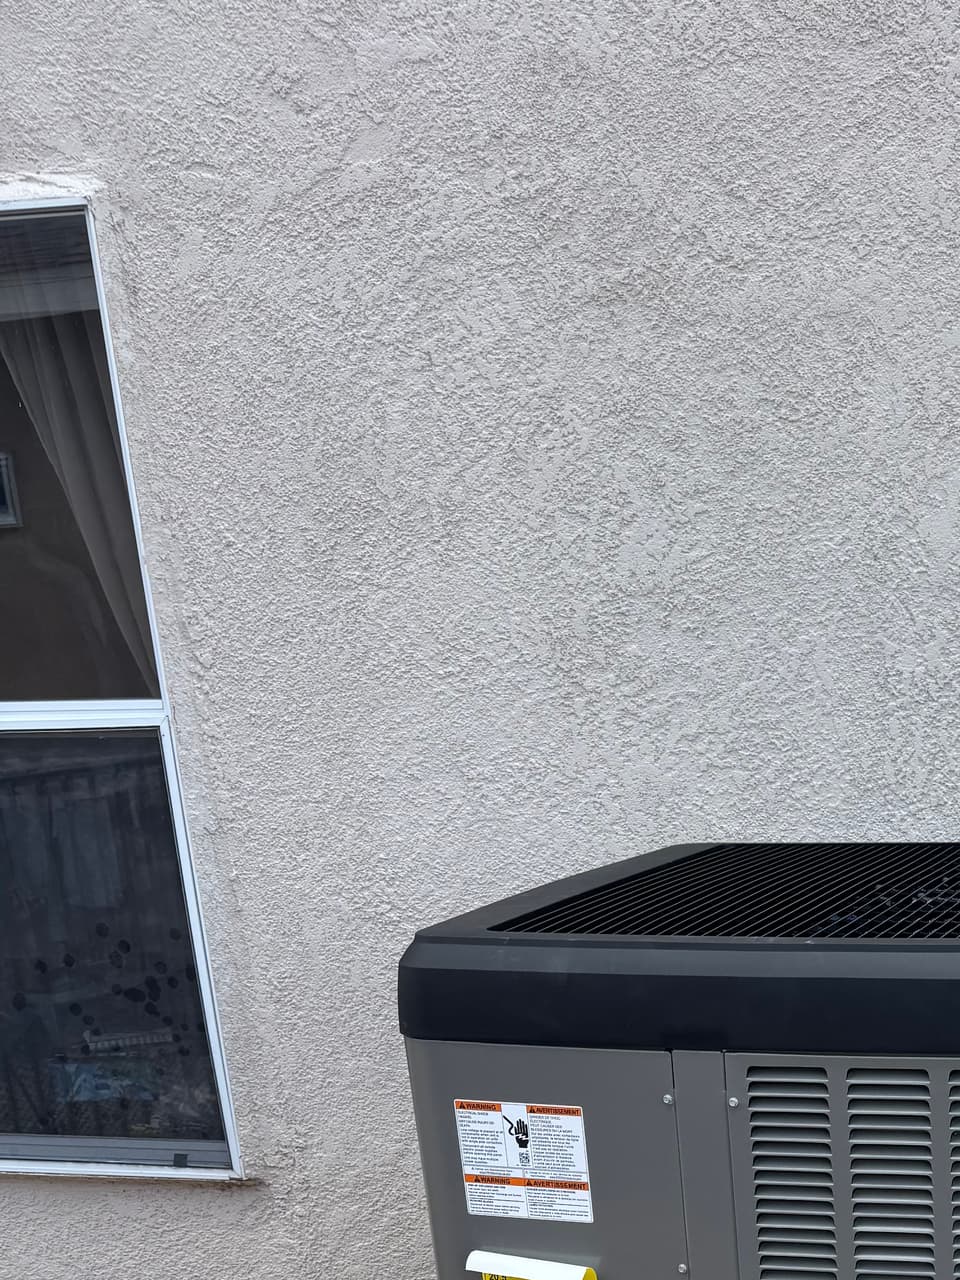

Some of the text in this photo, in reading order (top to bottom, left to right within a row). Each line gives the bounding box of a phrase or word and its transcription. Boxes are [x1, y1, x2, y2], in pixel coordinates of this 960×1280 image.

[466, 1102, 496, 1110] WARNING
[536, 1106, 579, 1115] AVERTISSEMENT
[534, 1180, 586, 1190] AVERTISSEMENT
